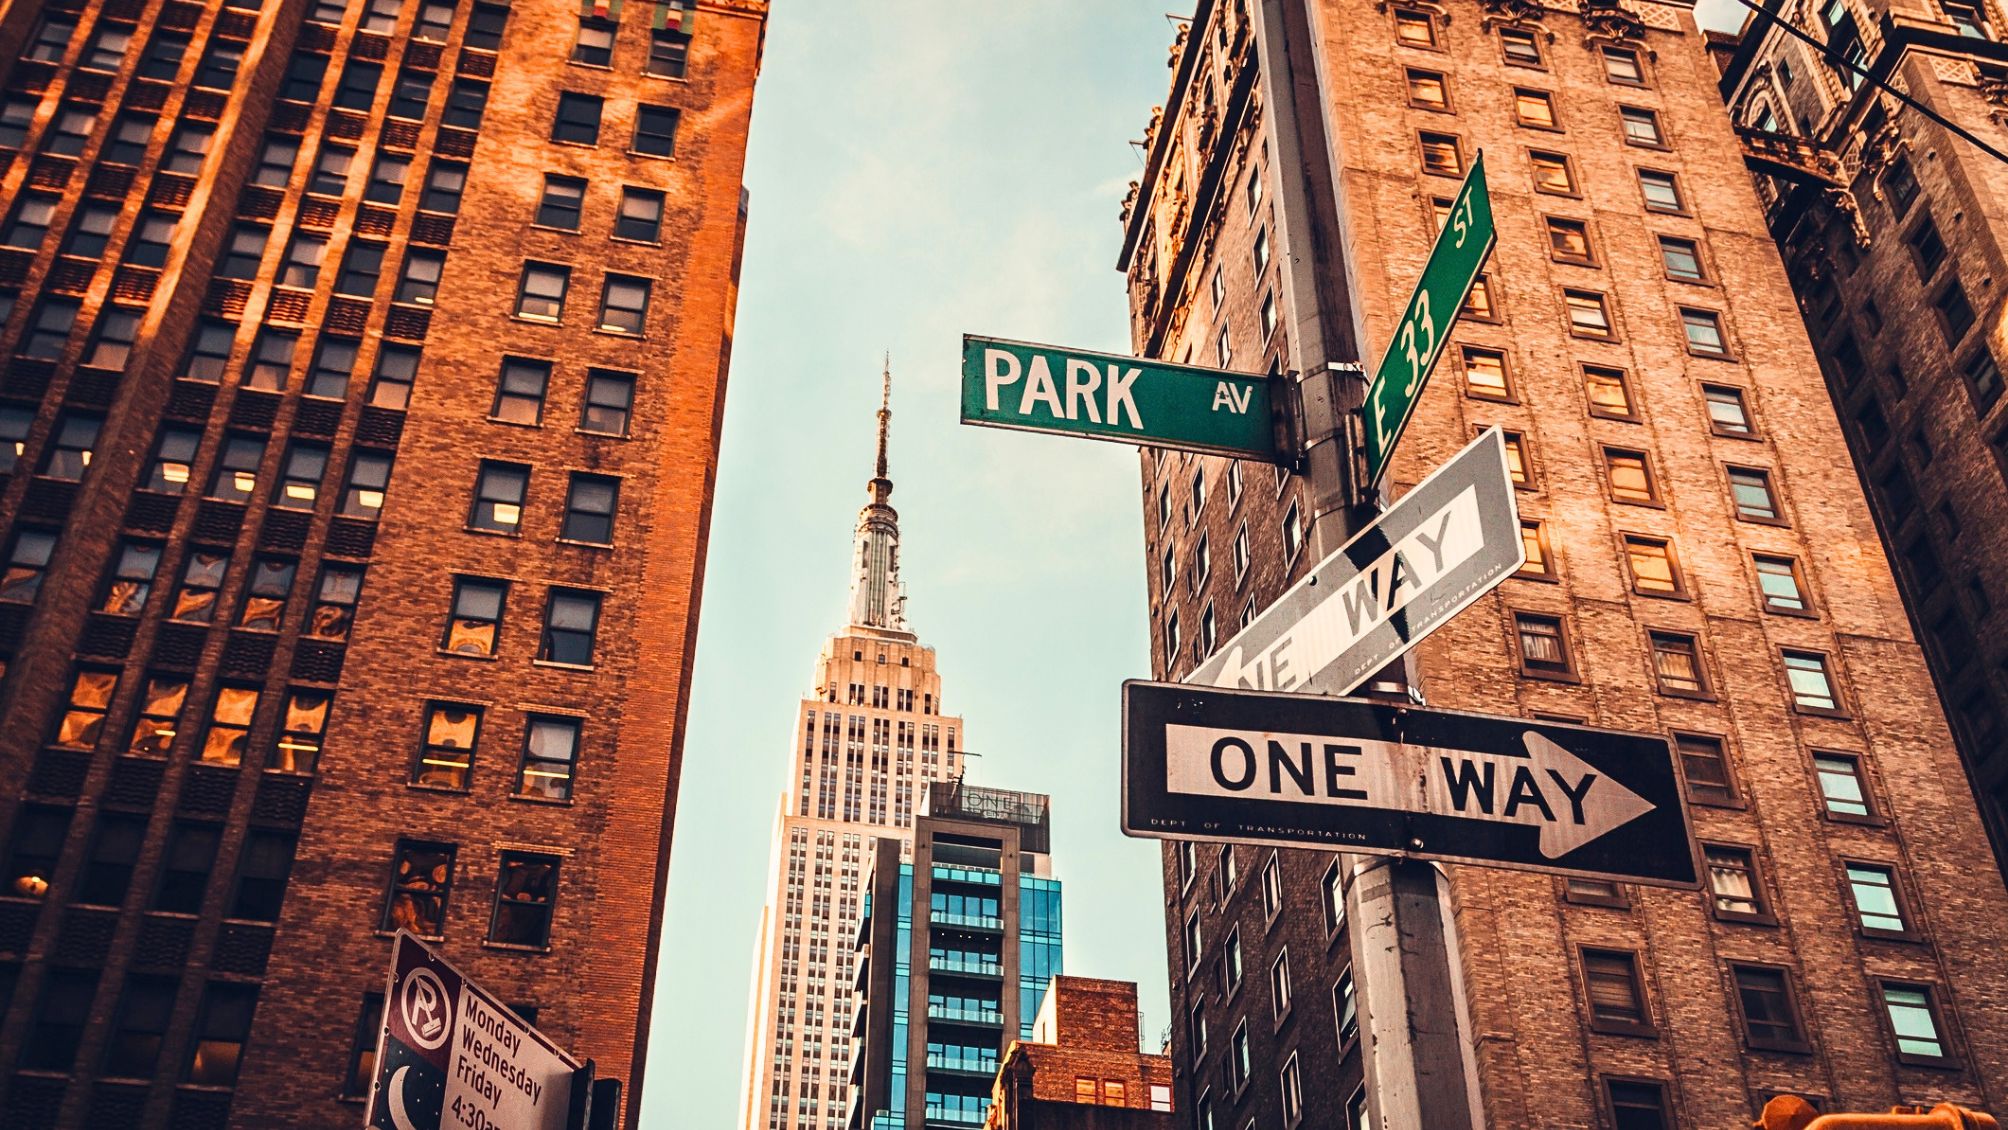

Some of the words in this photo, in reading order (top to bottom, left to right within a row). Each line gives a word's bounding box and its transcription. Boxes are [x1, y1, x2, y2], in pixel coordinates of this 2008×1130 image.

[1374, 376, 1392, 457] E
[1401, 289, 1434, 398] 33
[1454, 187, 1474, 249] ST
[985, 348, 1144, 430] PARK
[1212, 381, 1253, 415] AV
[1238, 637, 1292, 692] NE
[1342, 510, 1452, 637] WAY
[1354, 654, 1379, 675] DEPT
[1411, 562, 1502, 633] TRANSPORTATION
[1210, 736, 1368, 801] ONE
[1440, 756, 1597, 825] WAY
[1151, 818, 1186, 827] DEPT
[1204, 822, 1221, 830] OF
[1238, 824, 1367, 841] TRANSPORTATION
[462, 1025, 542, 1106] Wednesday
[465, 996, 521, 1058] Monday
[451, 1094, 501, 1130] 4:30a
[456, 1055, 502, 1110] Friday
